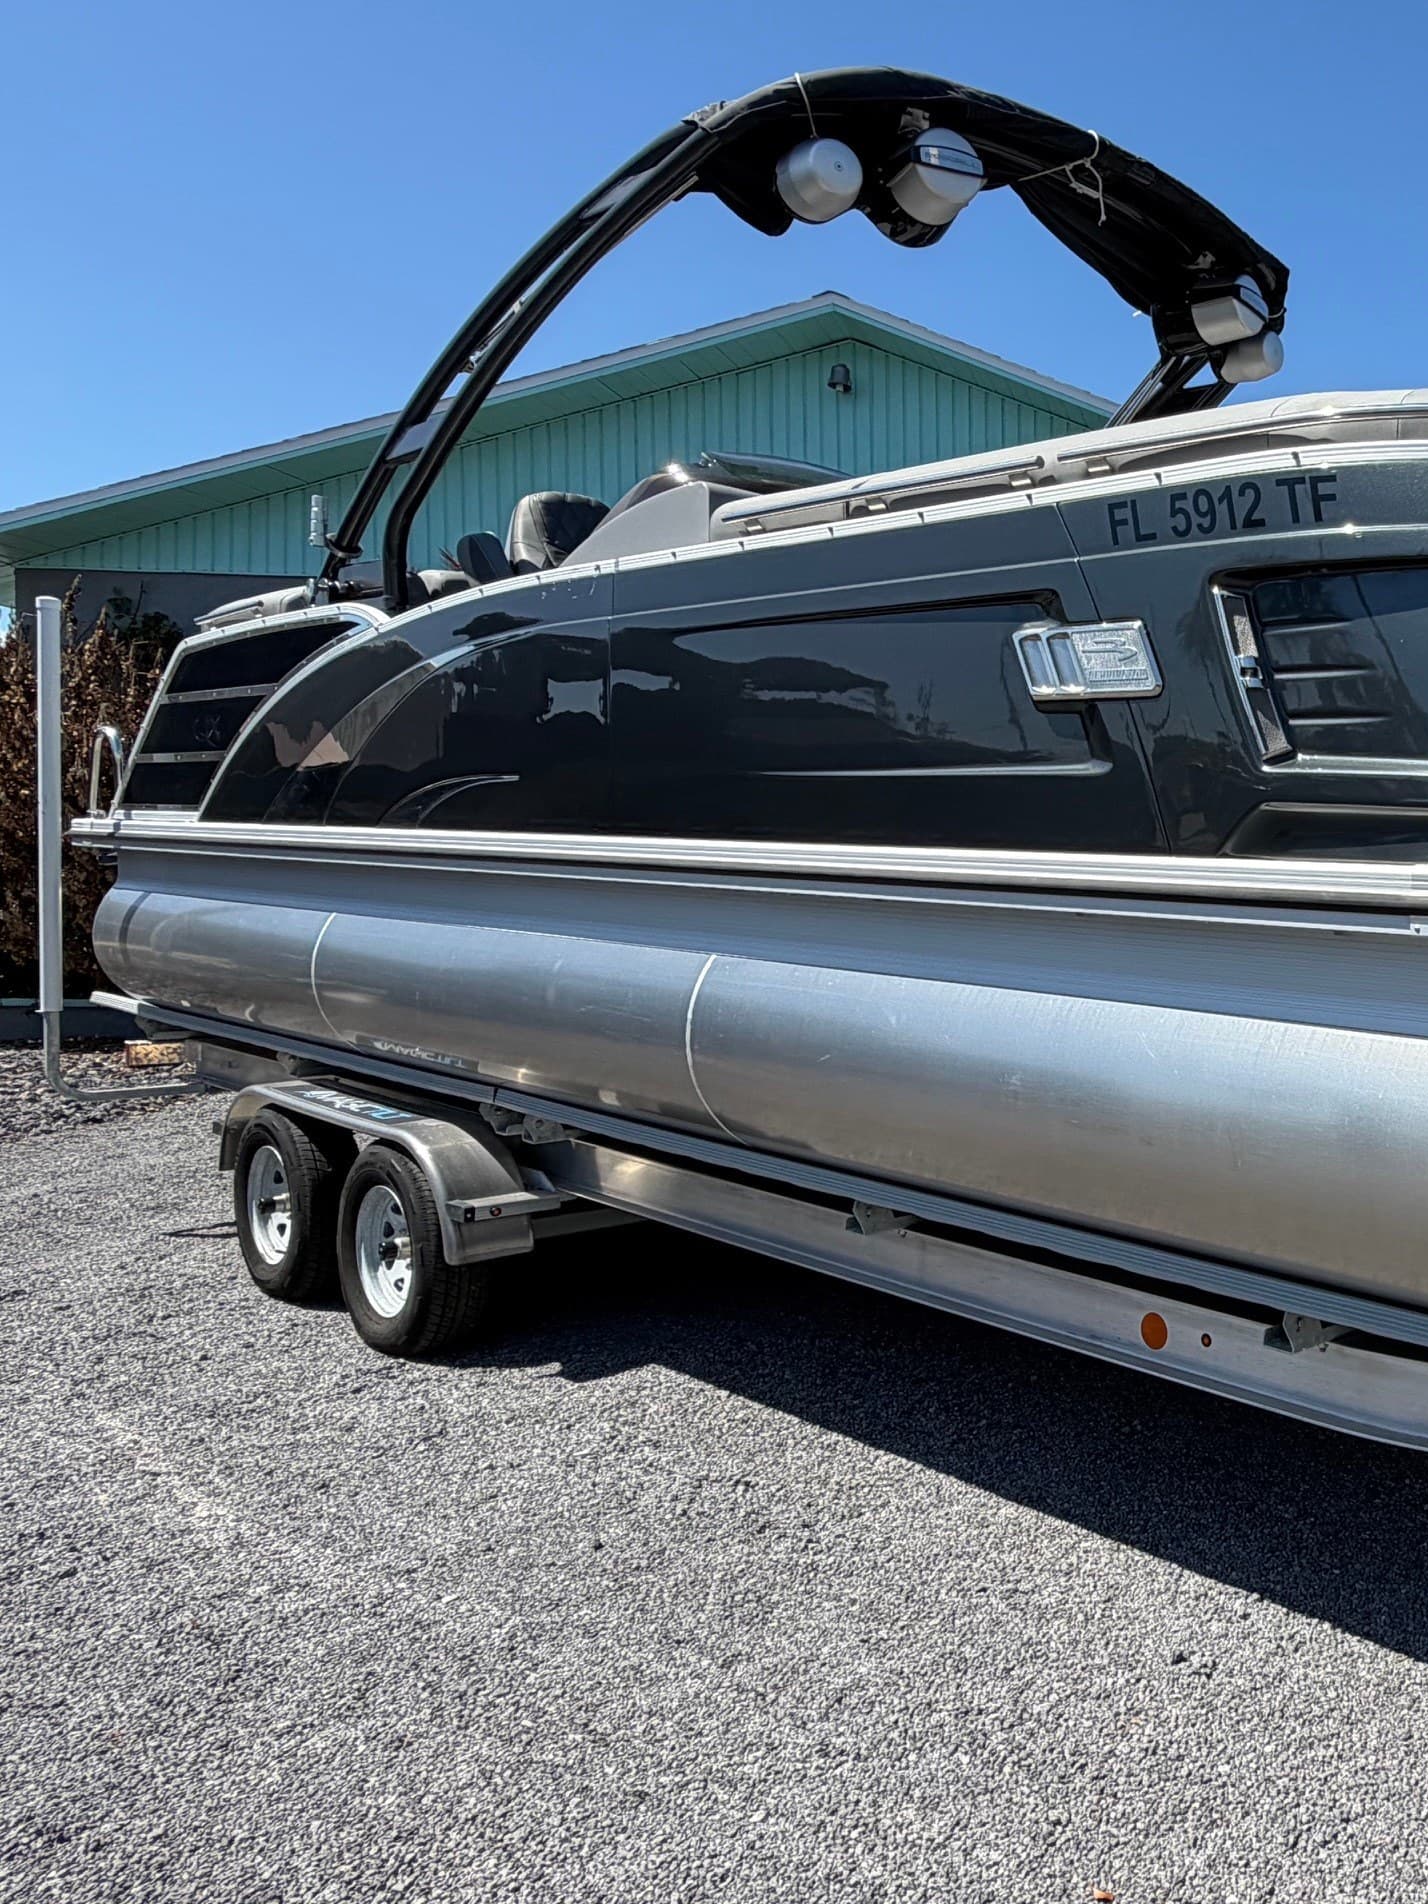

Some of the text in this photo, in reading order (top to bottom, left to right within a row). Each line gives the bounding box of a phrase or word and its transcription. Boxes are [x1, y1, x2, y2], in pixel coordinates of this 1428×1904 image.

[1107, 474, 1338, 546] FL 5912 TF
